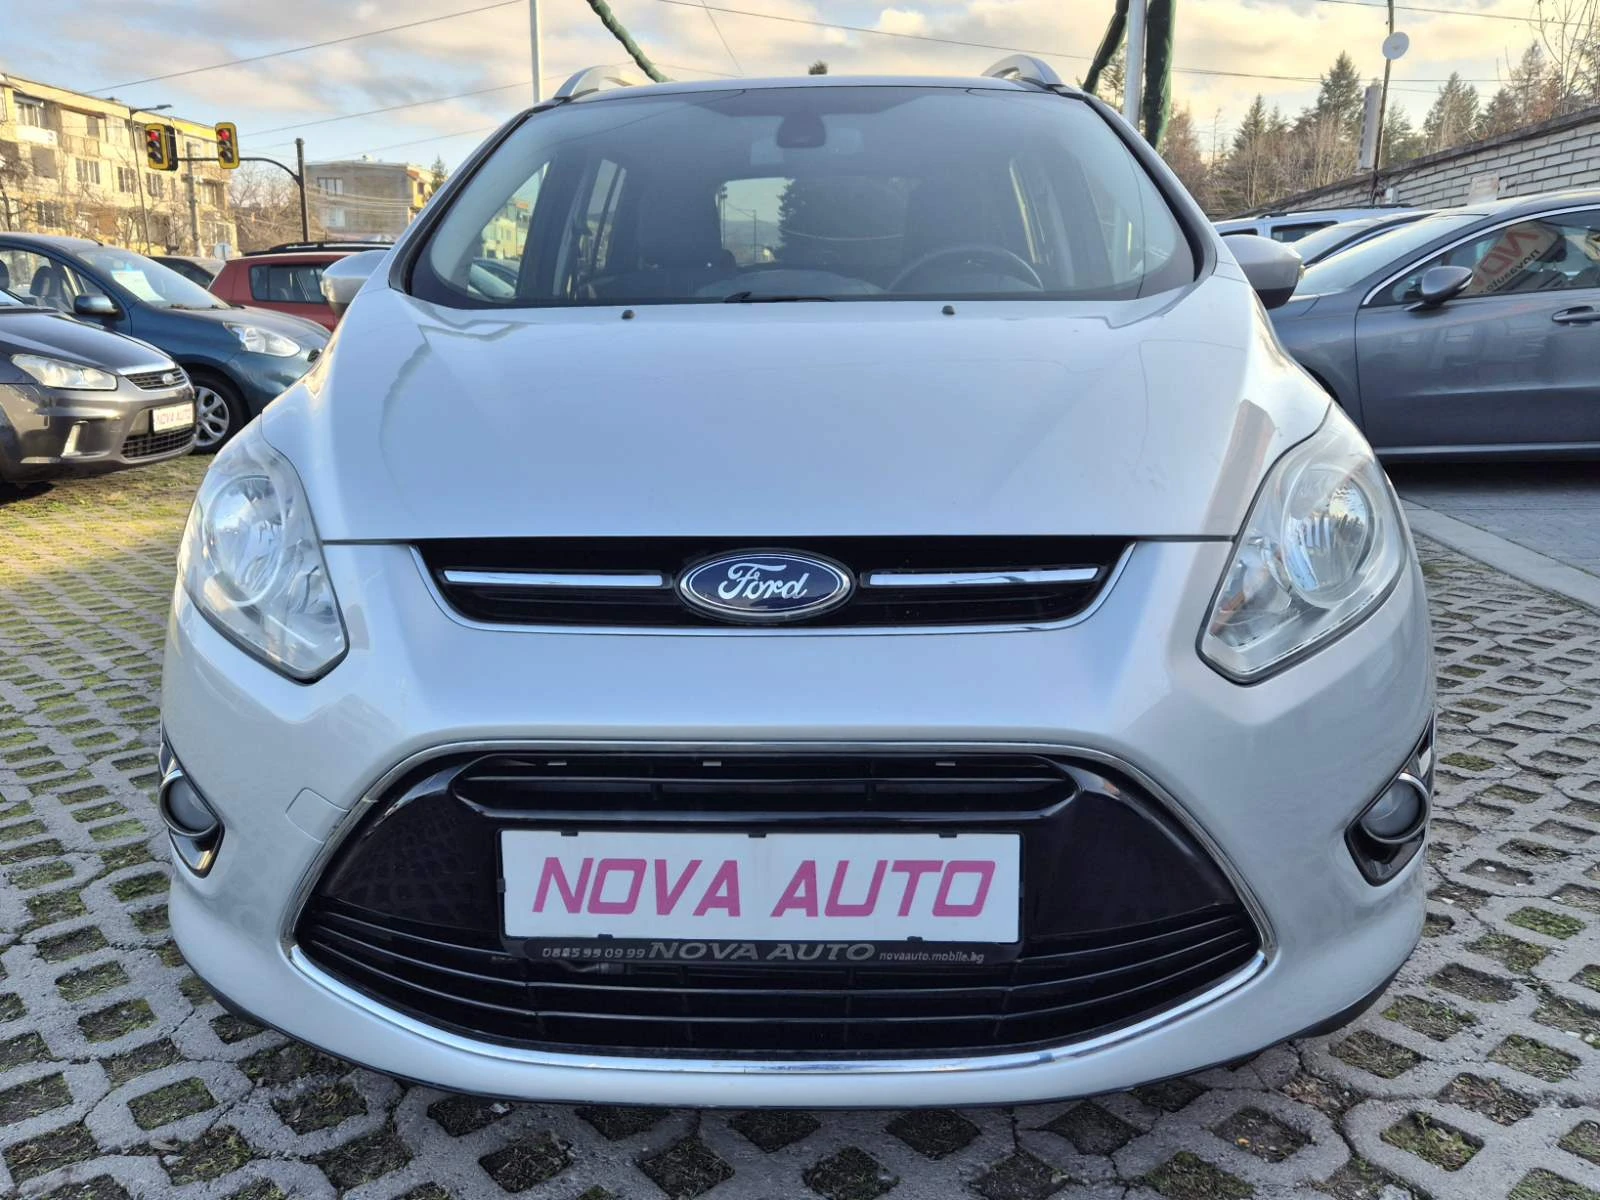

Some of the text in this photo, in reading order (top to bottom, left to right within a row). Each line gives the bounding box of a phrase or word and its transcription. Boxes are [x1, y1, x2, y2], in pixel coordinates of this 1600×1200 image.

[718, 562, 810, 600] Ford
[532, 856, 996, 918] NOVA AUTO
[649, 942, 758, 960] NOVA
[766, 943, 875, 961] AUTO
